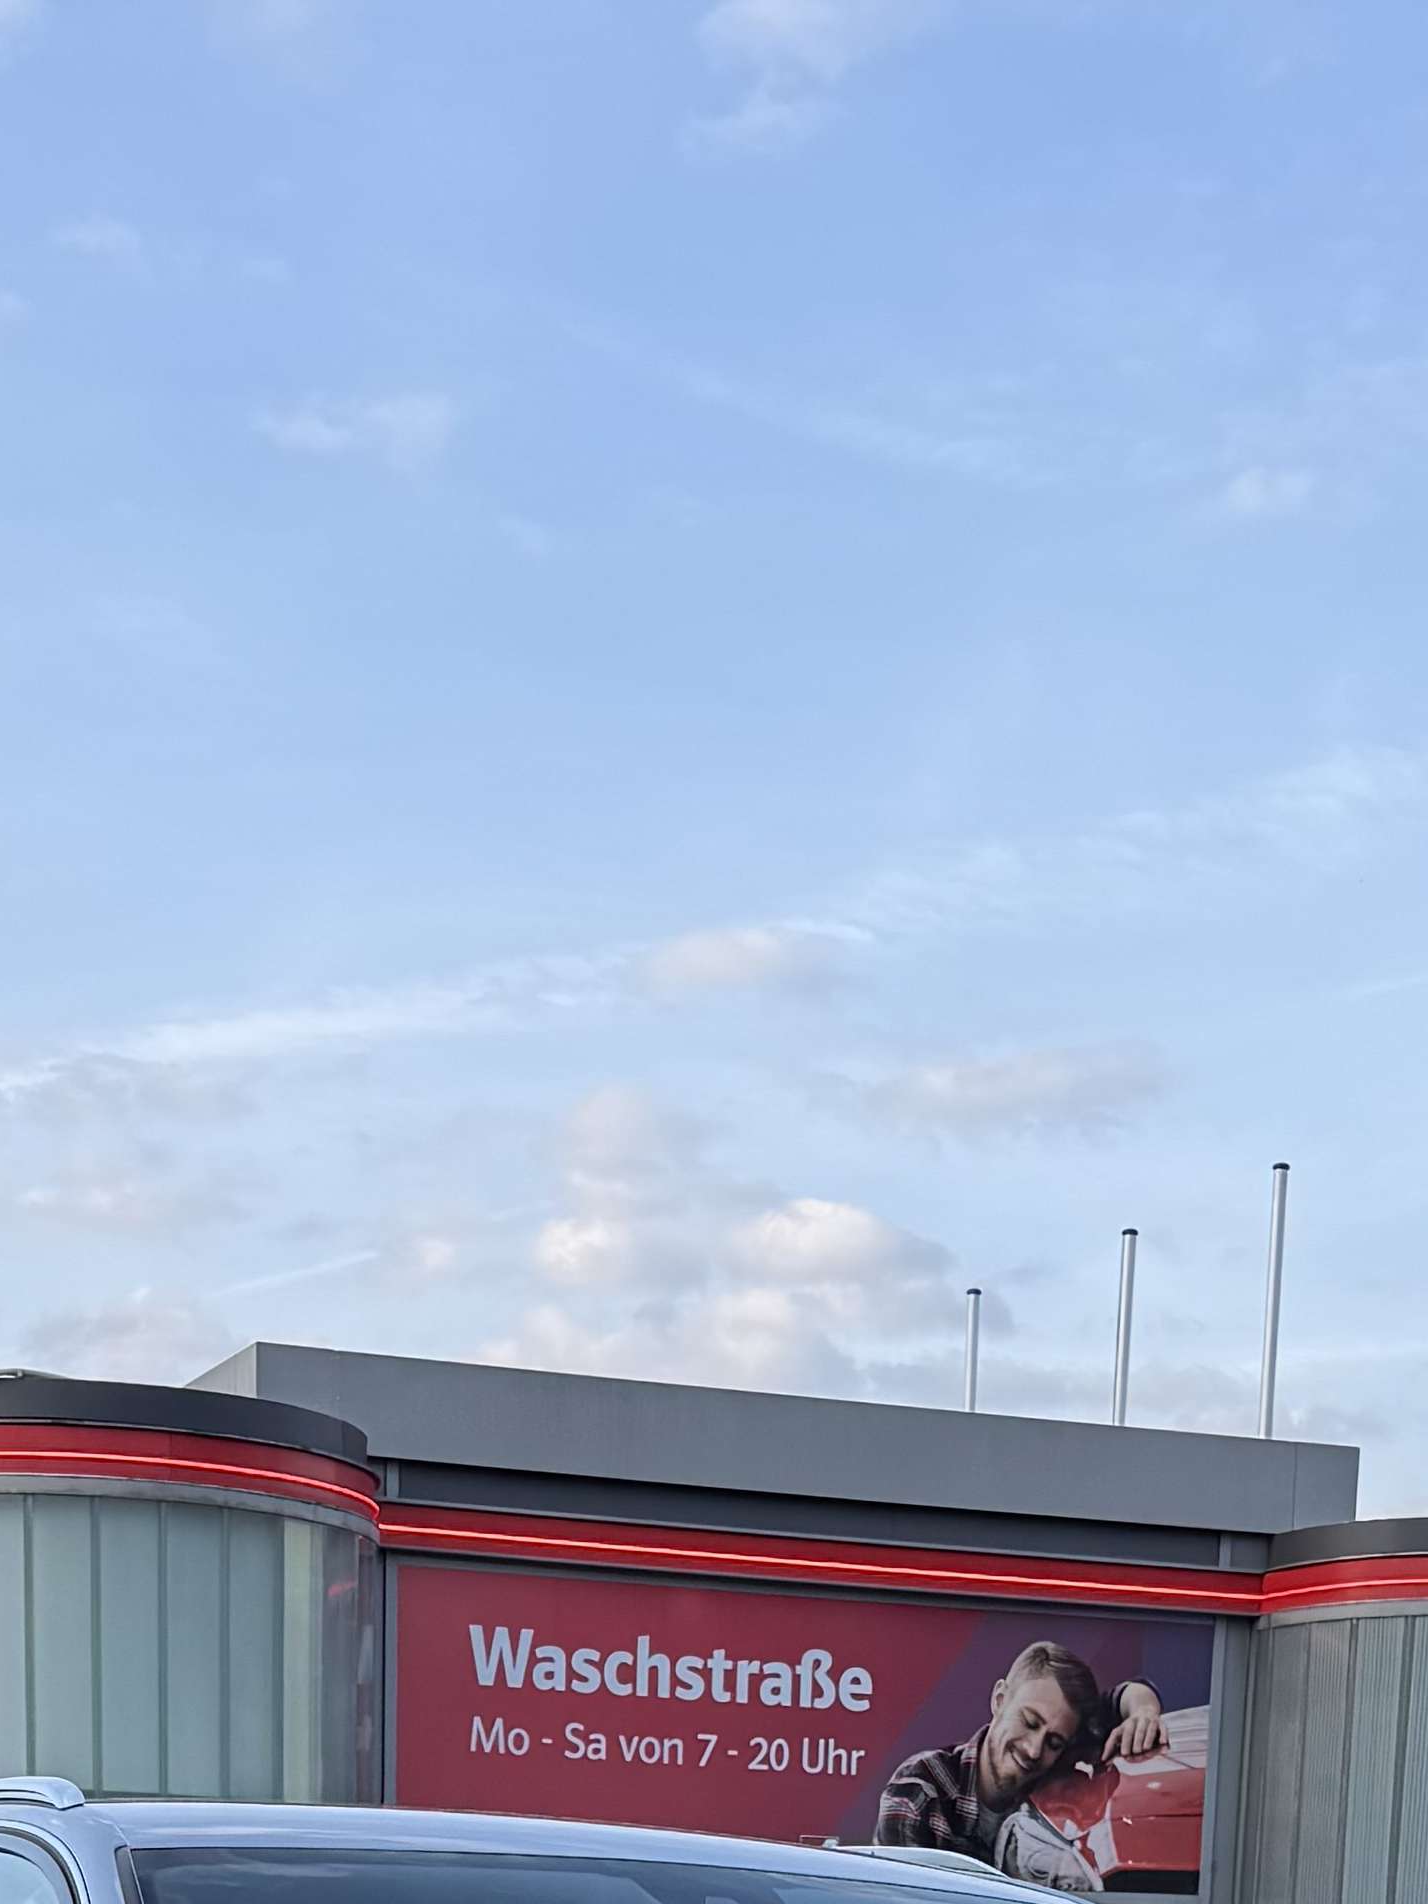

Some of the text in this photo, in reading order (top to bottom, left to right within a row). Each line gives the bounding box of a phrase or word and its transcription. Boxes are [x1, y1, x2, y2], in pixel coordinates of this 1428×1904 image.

[468, 1624, 873, 1712] Waschstraße
[470, 1716, 530, 1756] Mo
[564, 1722, 607, 1761] Sa
[618, 1735, 684, 1765] von
[697, 1733, 718, 1767] 7
[747, 1736, 790, 1772] 20
[802, 1737, 866, 1776] Uhr
